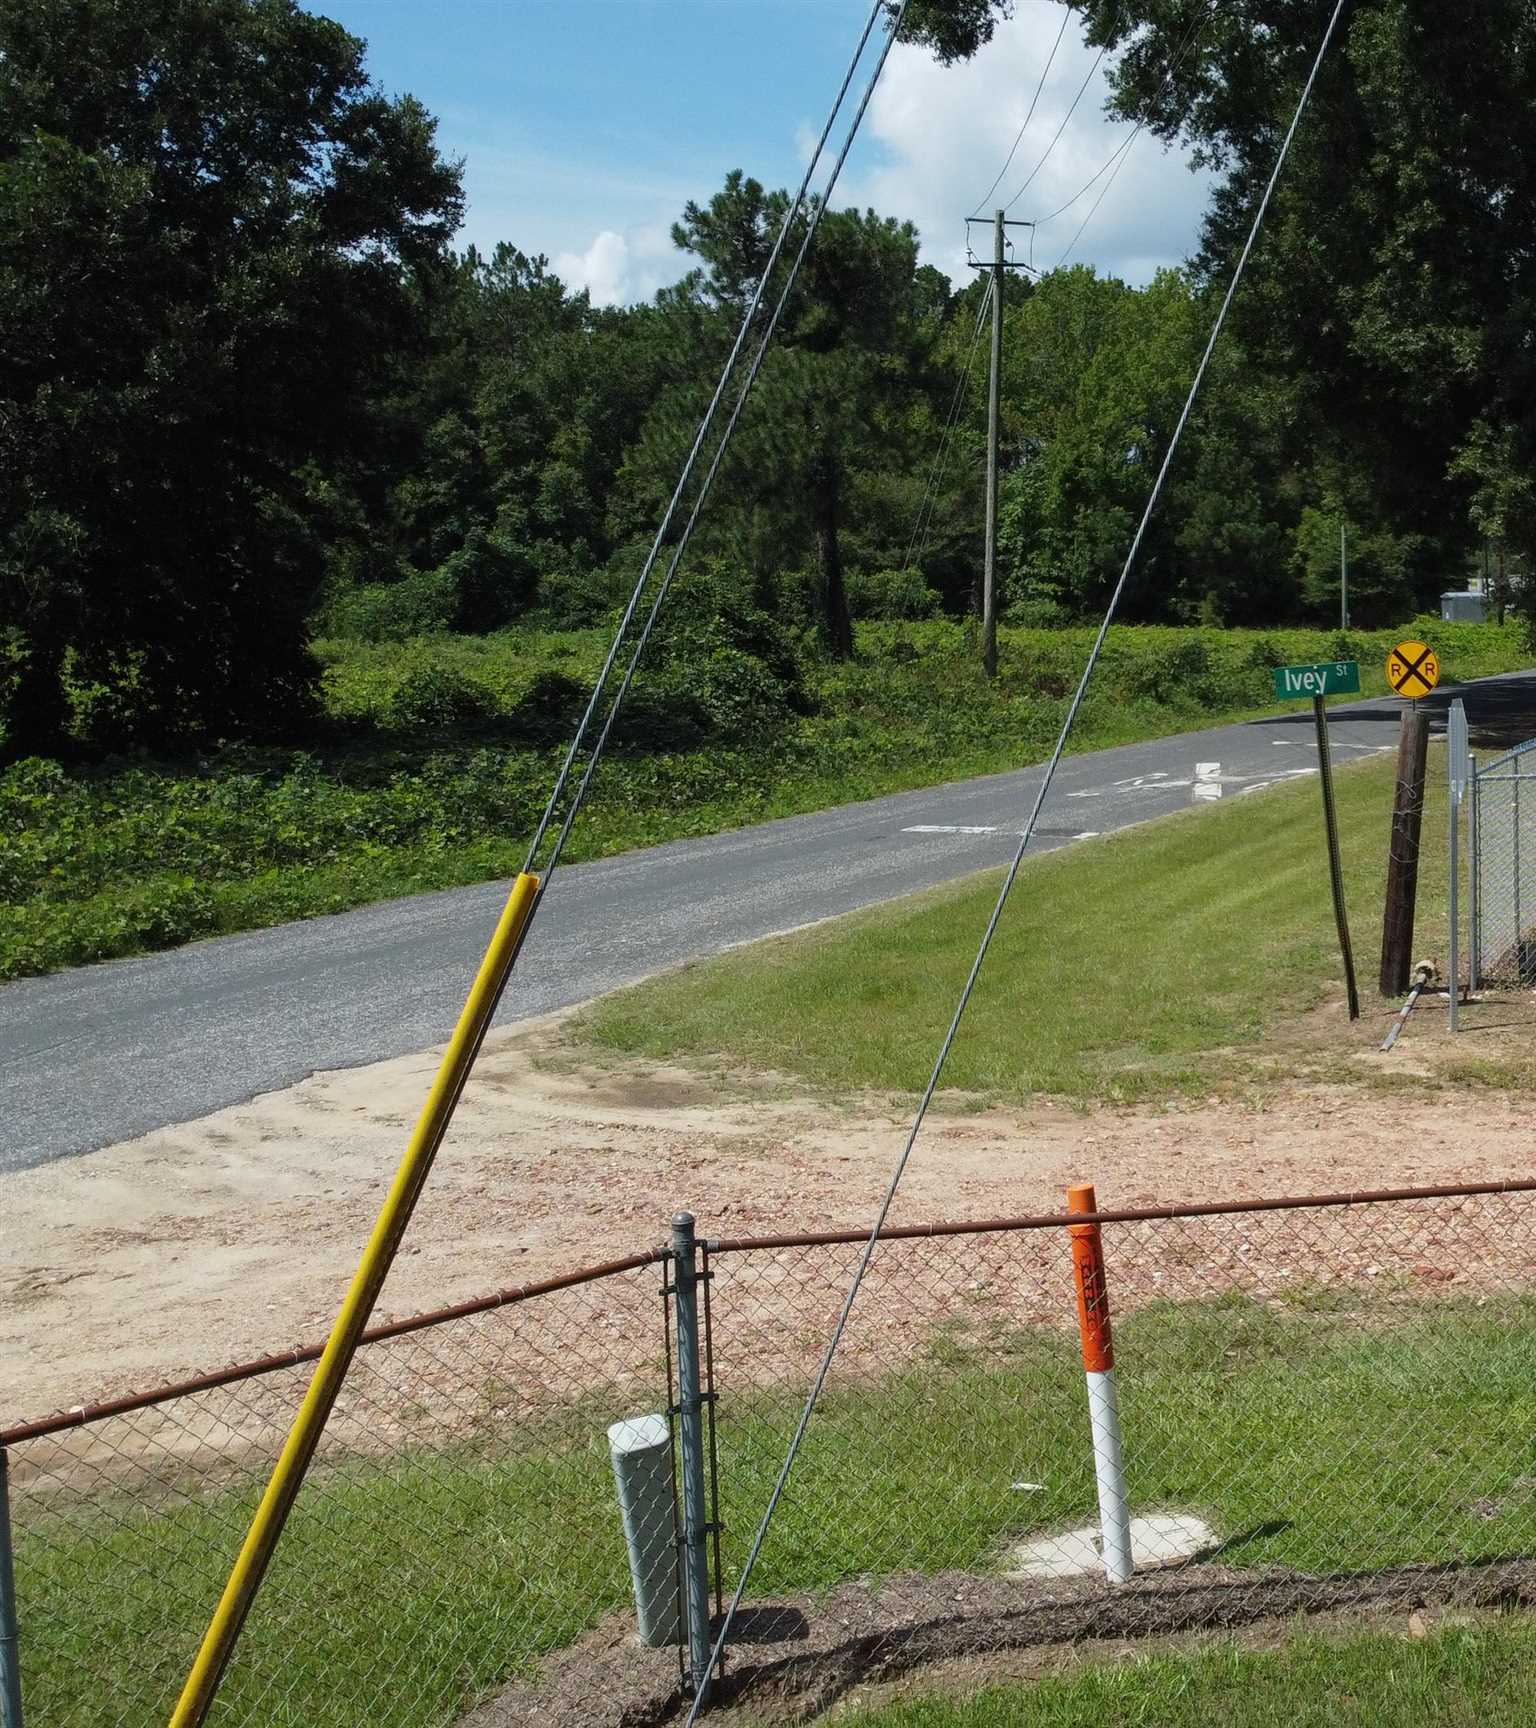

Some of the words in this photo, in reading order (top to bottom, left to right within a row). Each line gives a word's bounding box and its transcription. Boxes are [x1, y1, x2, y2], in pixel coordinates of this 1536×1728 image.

[1284, 669, 1327, 694] Ivey
[1335, 664, 1348, 677] St
[1391, 664, 1401, 677] R
[1425, 663, 1435, 676] R
